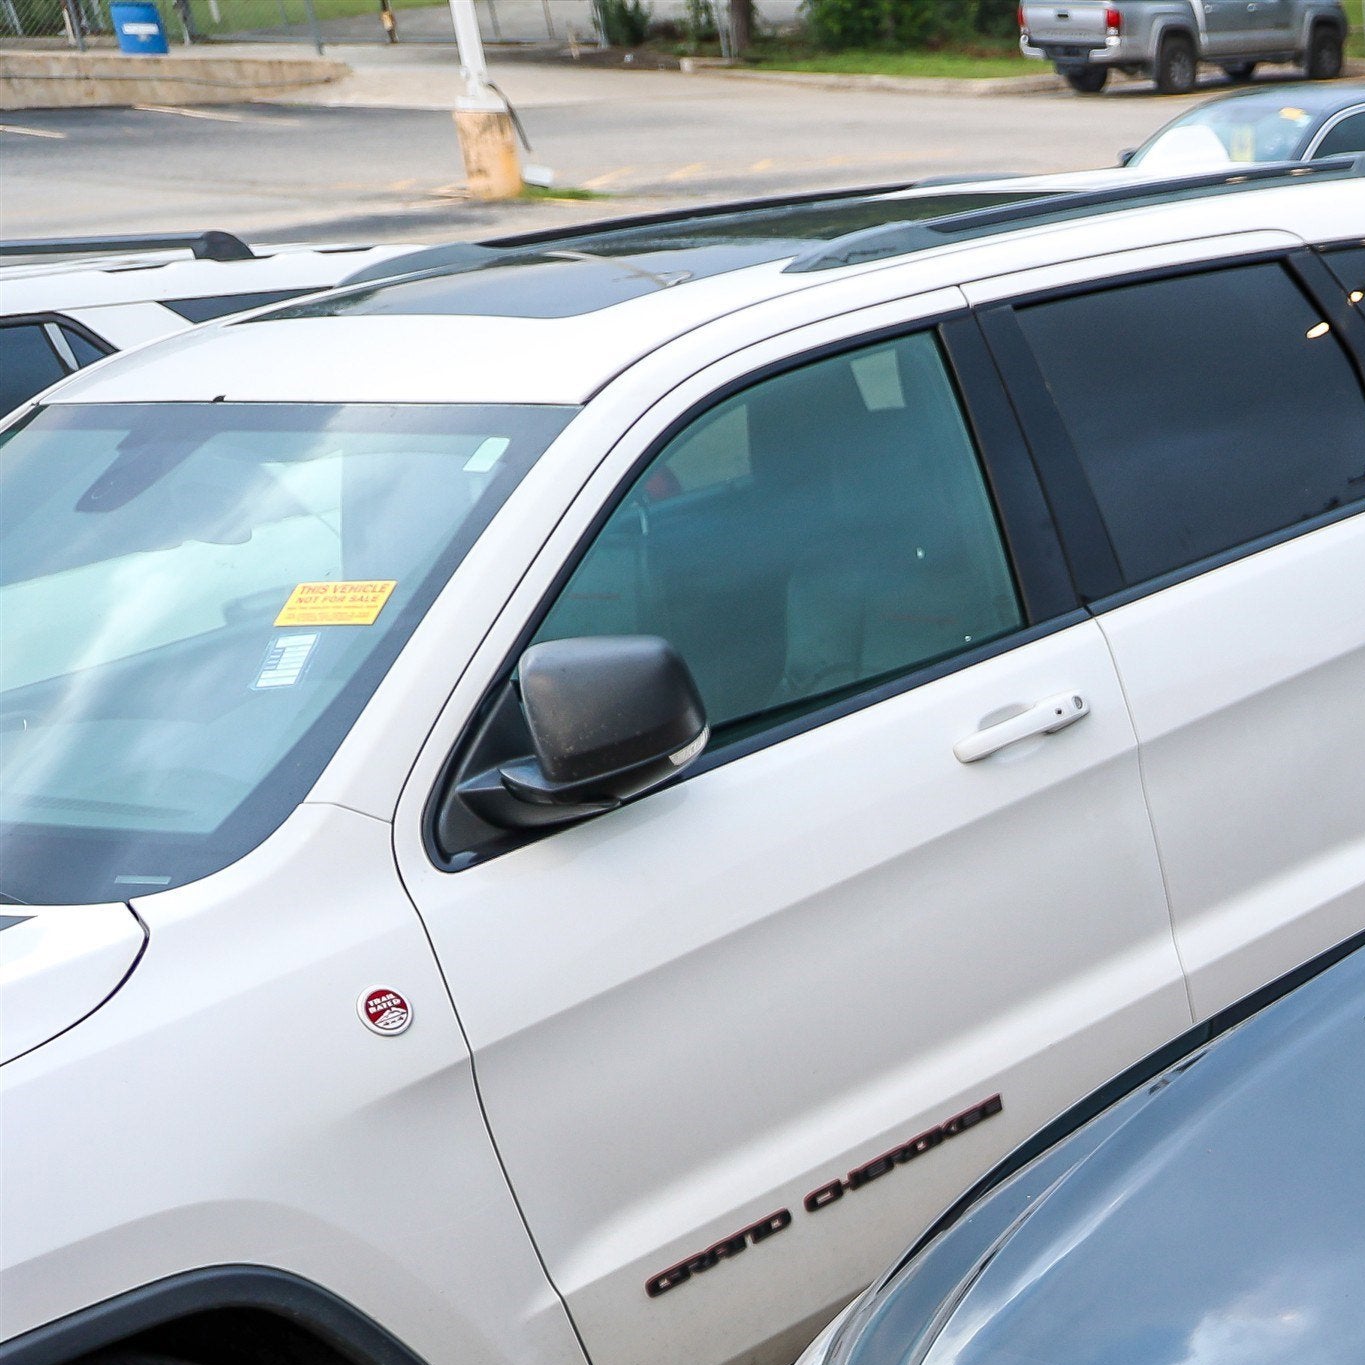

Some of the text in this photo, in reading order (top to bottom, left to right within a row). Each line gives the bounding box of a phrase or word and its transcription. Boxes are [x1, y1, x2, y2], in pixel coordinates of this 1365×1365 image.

[300, 583, 390, 595] THIS VEHICLE
[296, 595, 380, 604] NOT FOR SALE
[644, 1092, 1004, 1299] GRAND CHEROKEE
